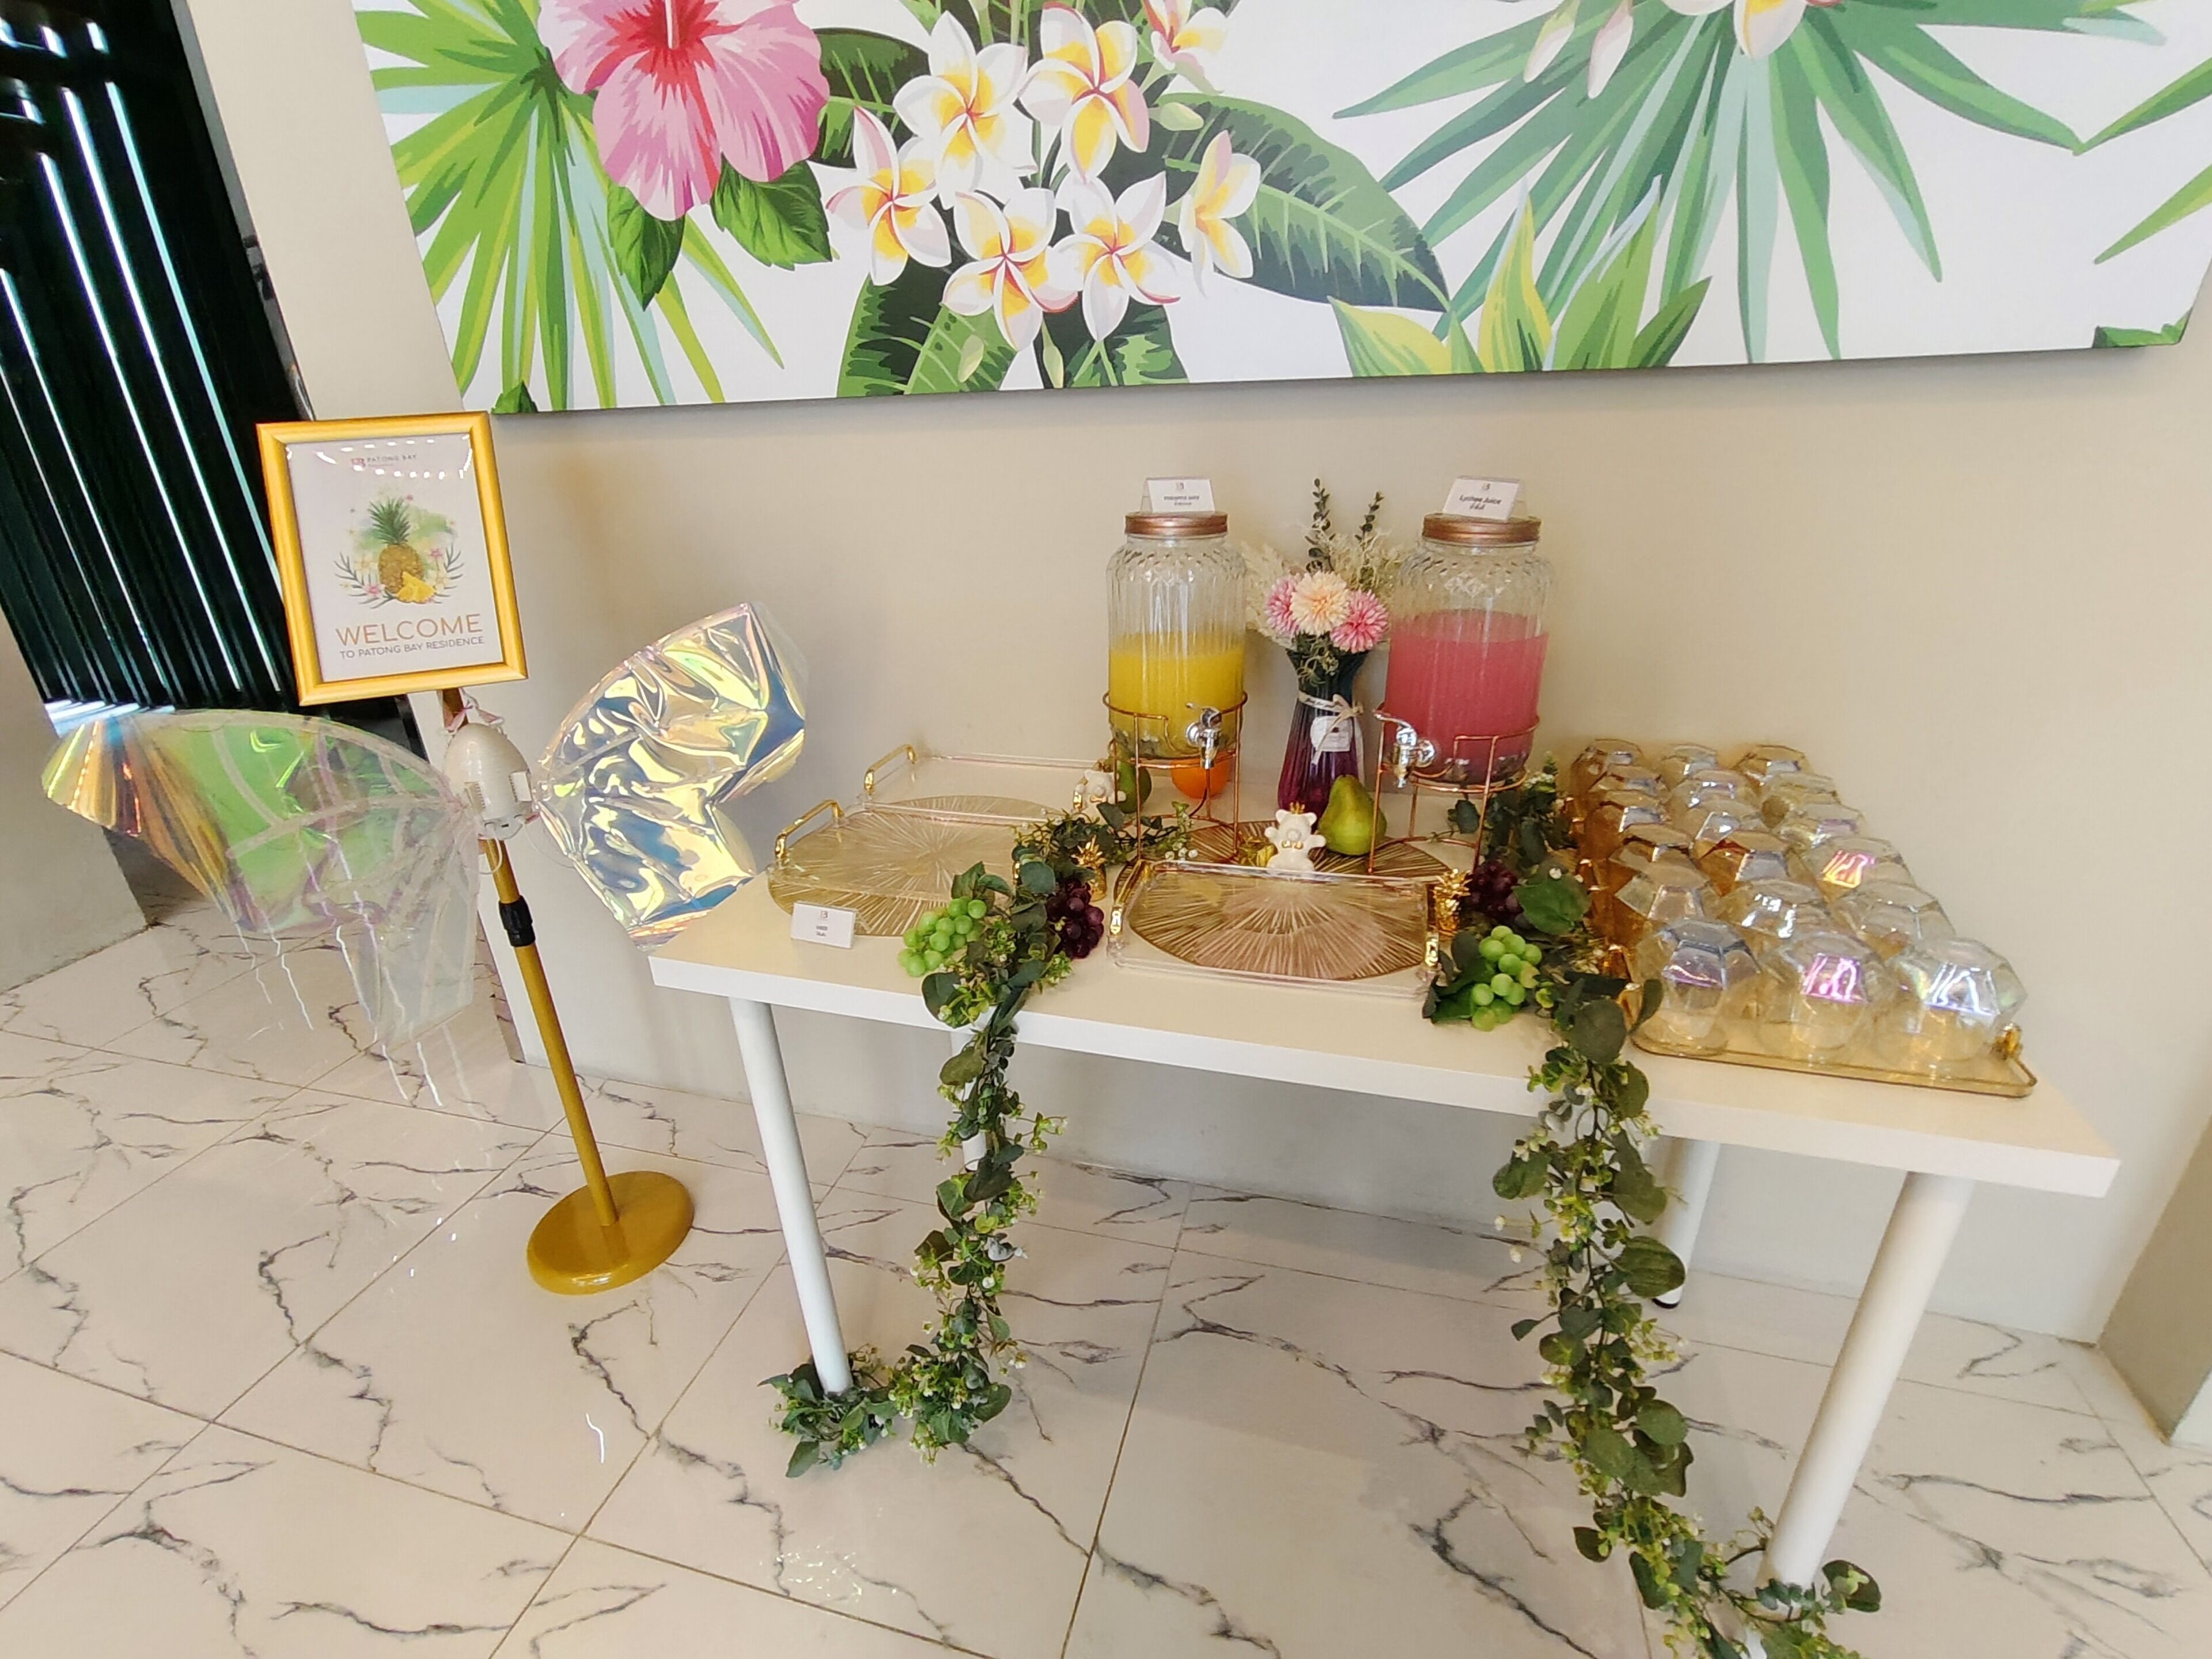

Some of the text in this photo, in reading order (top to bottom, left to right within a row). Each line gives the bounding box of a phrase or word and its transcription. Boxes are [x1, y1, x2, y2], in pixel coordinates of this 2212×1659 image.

[336, 613, 483, 646] WELCOME
[340, 636, 484, 659] TO PATONG BAY RESIDENCE
